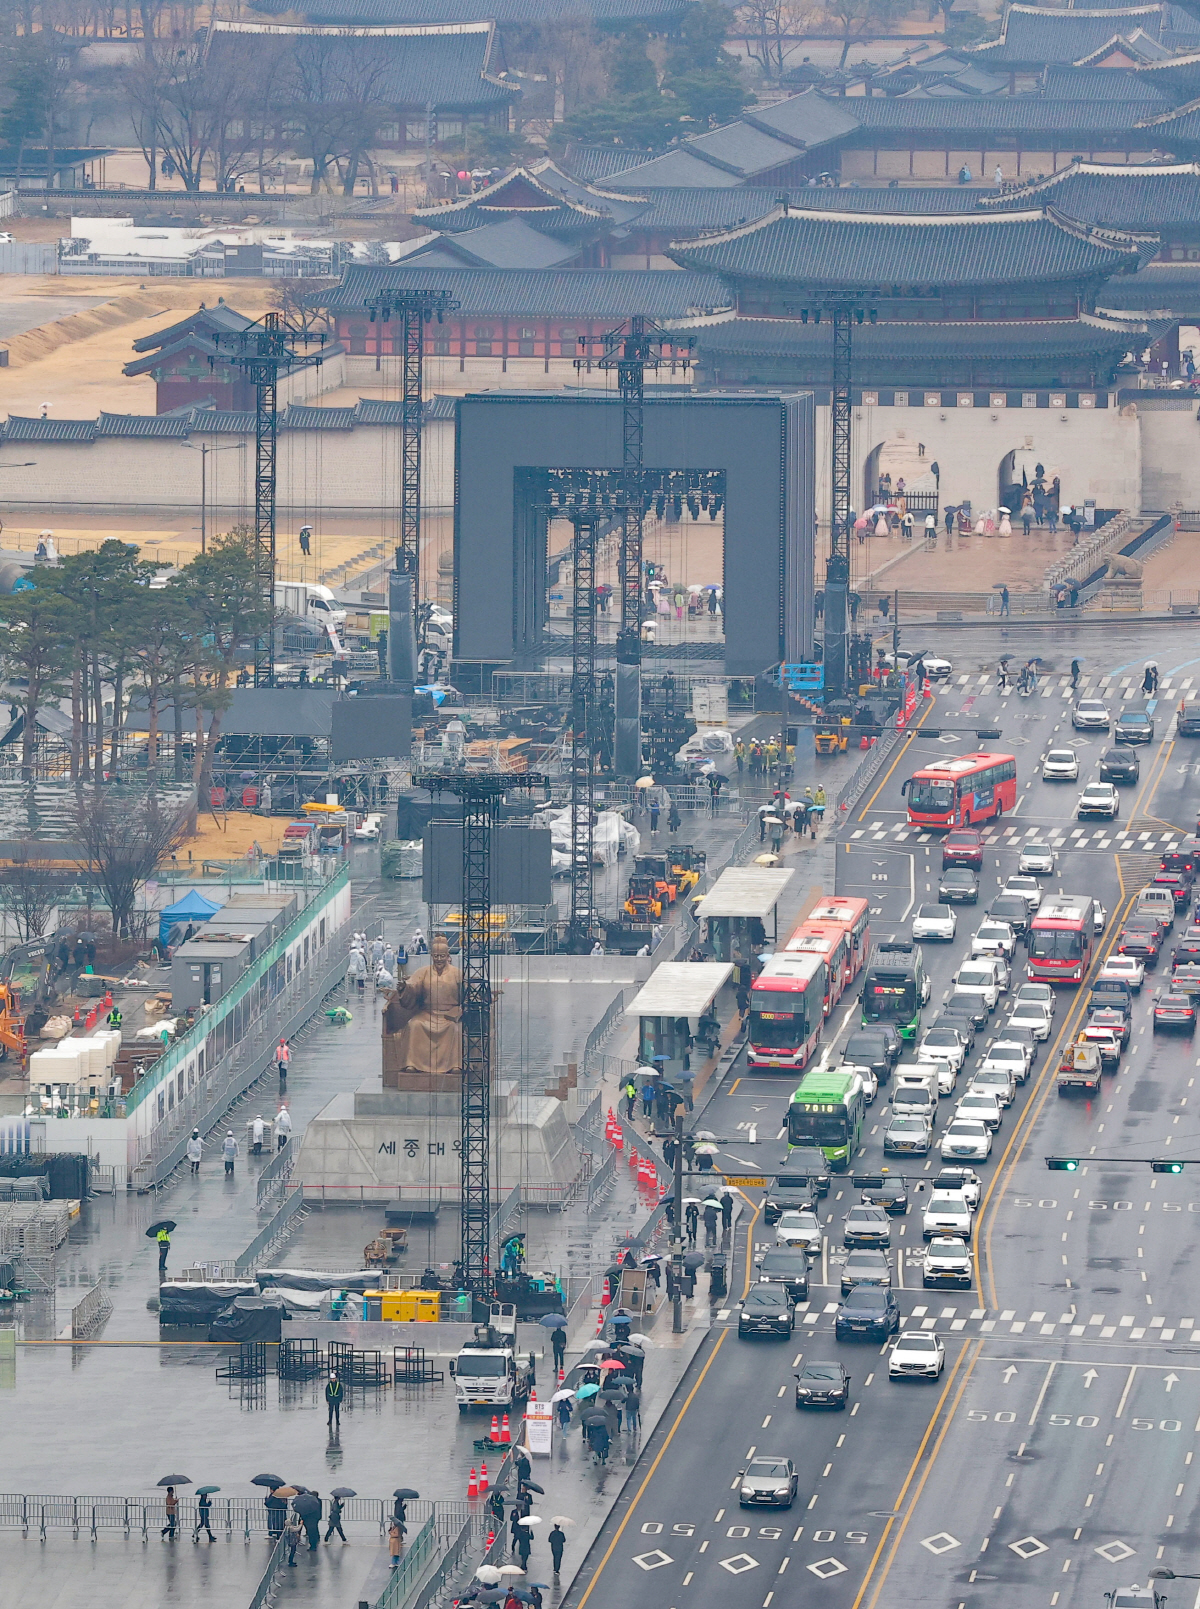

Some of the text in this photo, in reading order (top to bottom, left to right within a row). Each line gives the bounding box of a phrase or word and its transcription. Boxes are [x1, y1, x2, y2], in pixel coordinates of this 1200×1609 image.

[804, 1104, 833, 1112] 7018
[1013, 1198, 1058, 1209] 50
[1087, 1200, 1133, 1211] 50
[966, 1410, 1017, 1423] 50
[1048, 1414, 1100, 1428] 50
[1131, 1418, 1182, 1432] 50
[640, 1522, 696, 1537] 50
[725, 1526, 783, 1540] 50
[812, 1530, 869, 1544] 50
